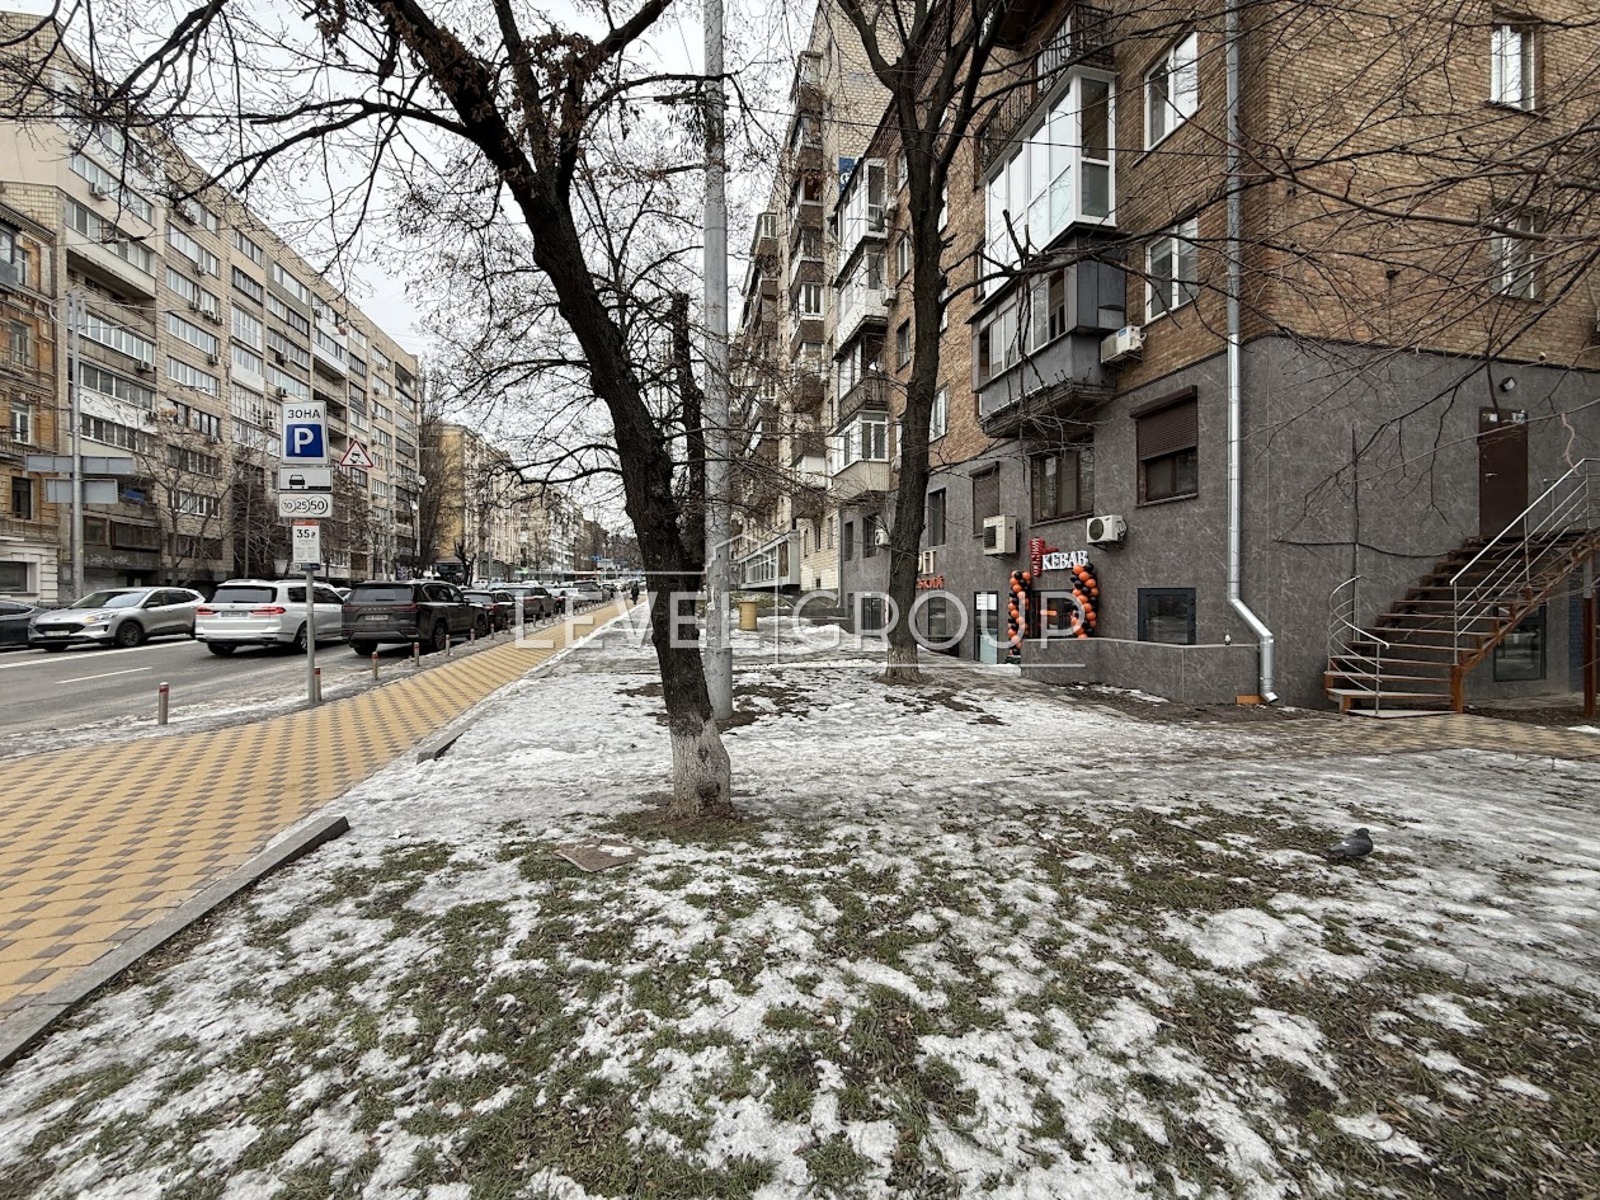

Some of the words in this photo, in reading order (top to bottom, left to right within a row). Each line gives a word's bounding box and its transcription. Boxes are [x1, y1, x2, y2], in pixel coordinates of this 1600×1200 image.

[288, 409, 321, 419] ЗОНА
[294, 427, 314, 454] P
[284, 502, 293, 510] 10
[296, 501, 307, 510] 25
[310, 500, 325, 510] 50
[1041, 550, 1088, 570] KEBAB
